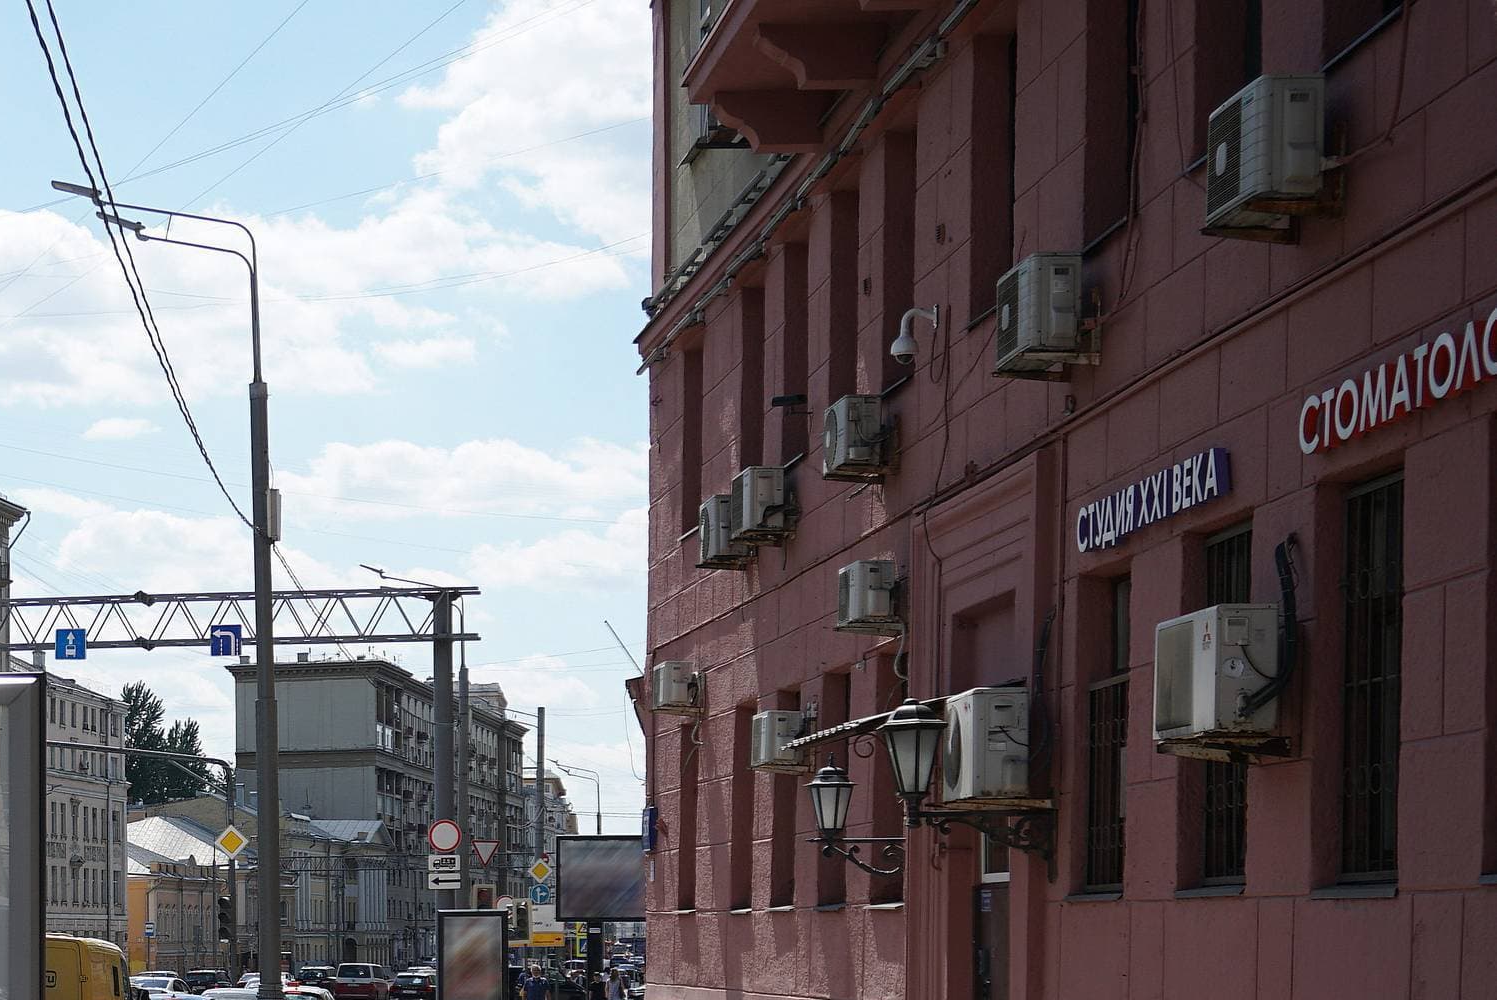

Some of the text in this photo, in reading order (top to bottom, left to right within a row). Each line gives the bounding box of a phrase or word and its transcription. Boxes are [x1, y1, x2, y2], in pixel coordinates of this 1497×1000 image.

[1077, 448, 1219, 553] СТУДИЯ XXI ВЕКА
